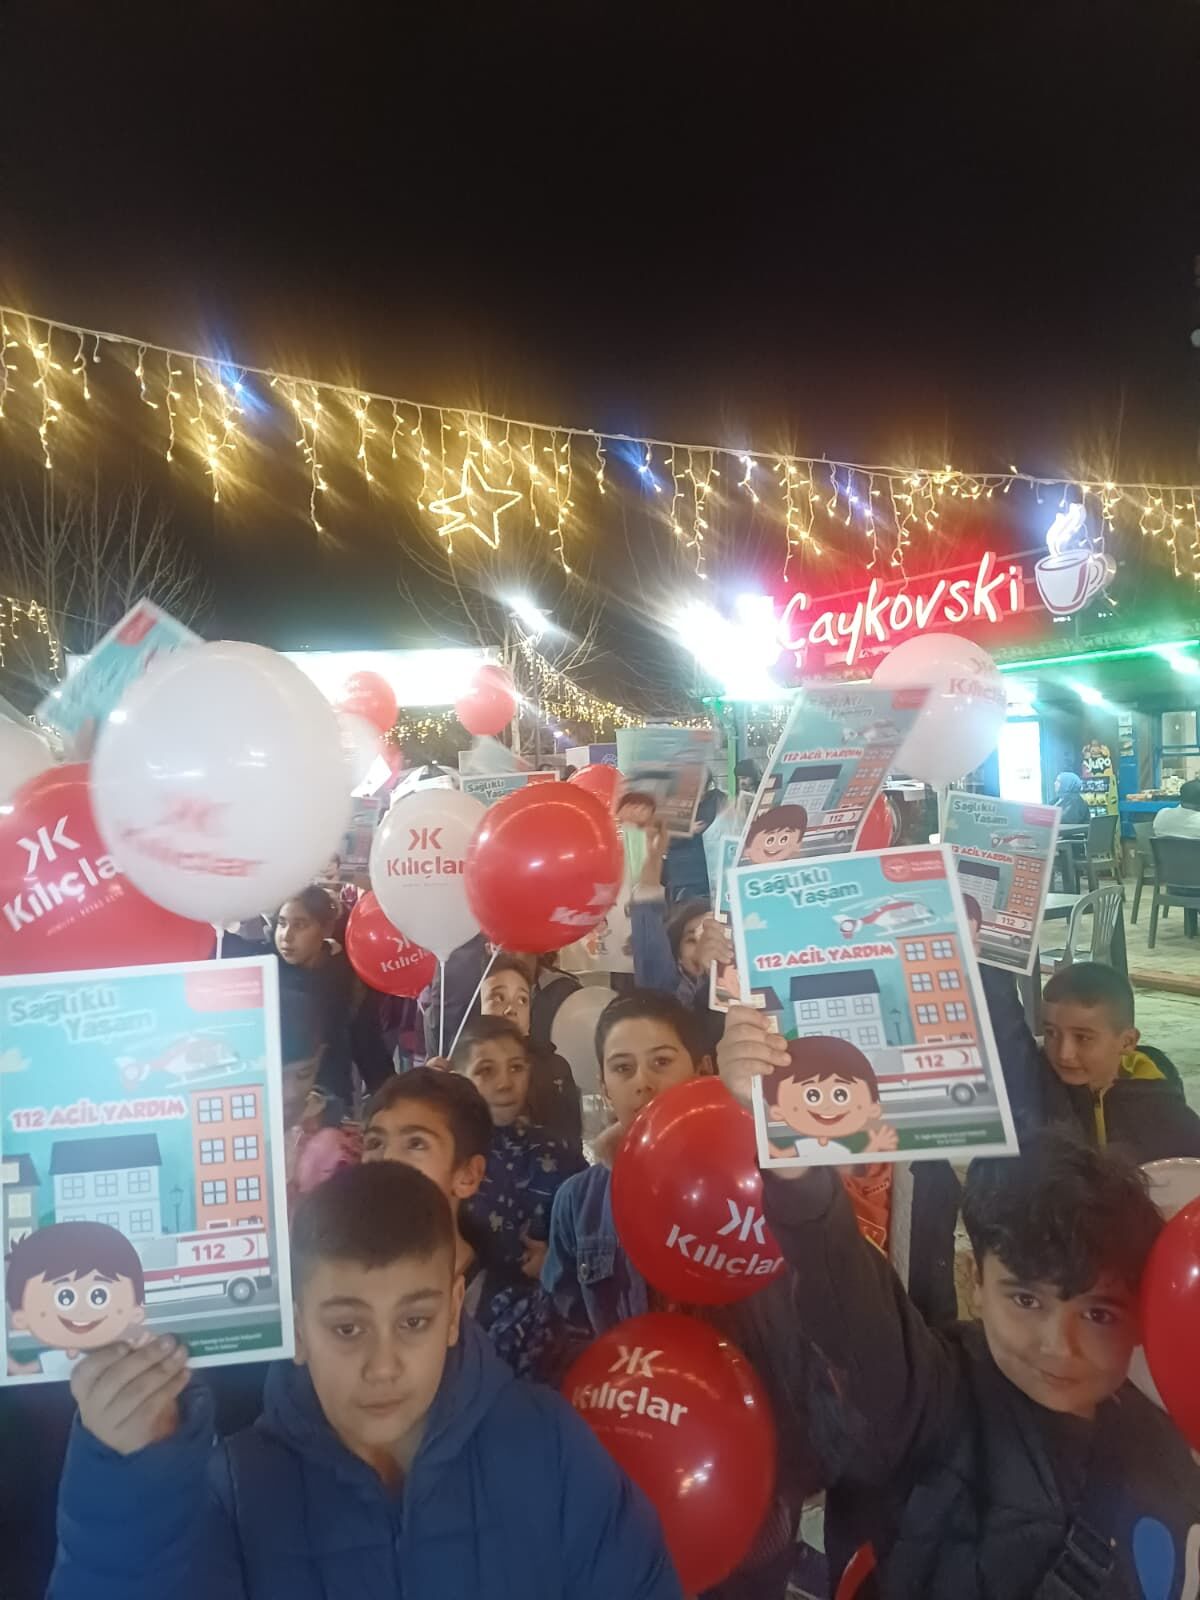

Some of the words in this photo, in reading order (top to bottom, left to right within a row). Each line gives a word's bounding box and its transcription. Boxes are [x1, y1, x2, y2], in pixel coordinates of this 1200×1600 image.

[829, 813, 844, 824] 112
[793, 884, 860, 908] Yaşam
[1001, 917, 1017, 926] 112
[756, 955, 783, 970] 112
[787, 946, 826, 965] ACİL
[828, 943, 895, 961] YARDIM
[915, 1053, 944, 1070] 112
[12, 1110, 45, 1128] 112
[50, 1101, 101, 1126] ACİL
[103, 1098, 185, 1121] YARDIM
[192, 1242, 226, 1262] 112
